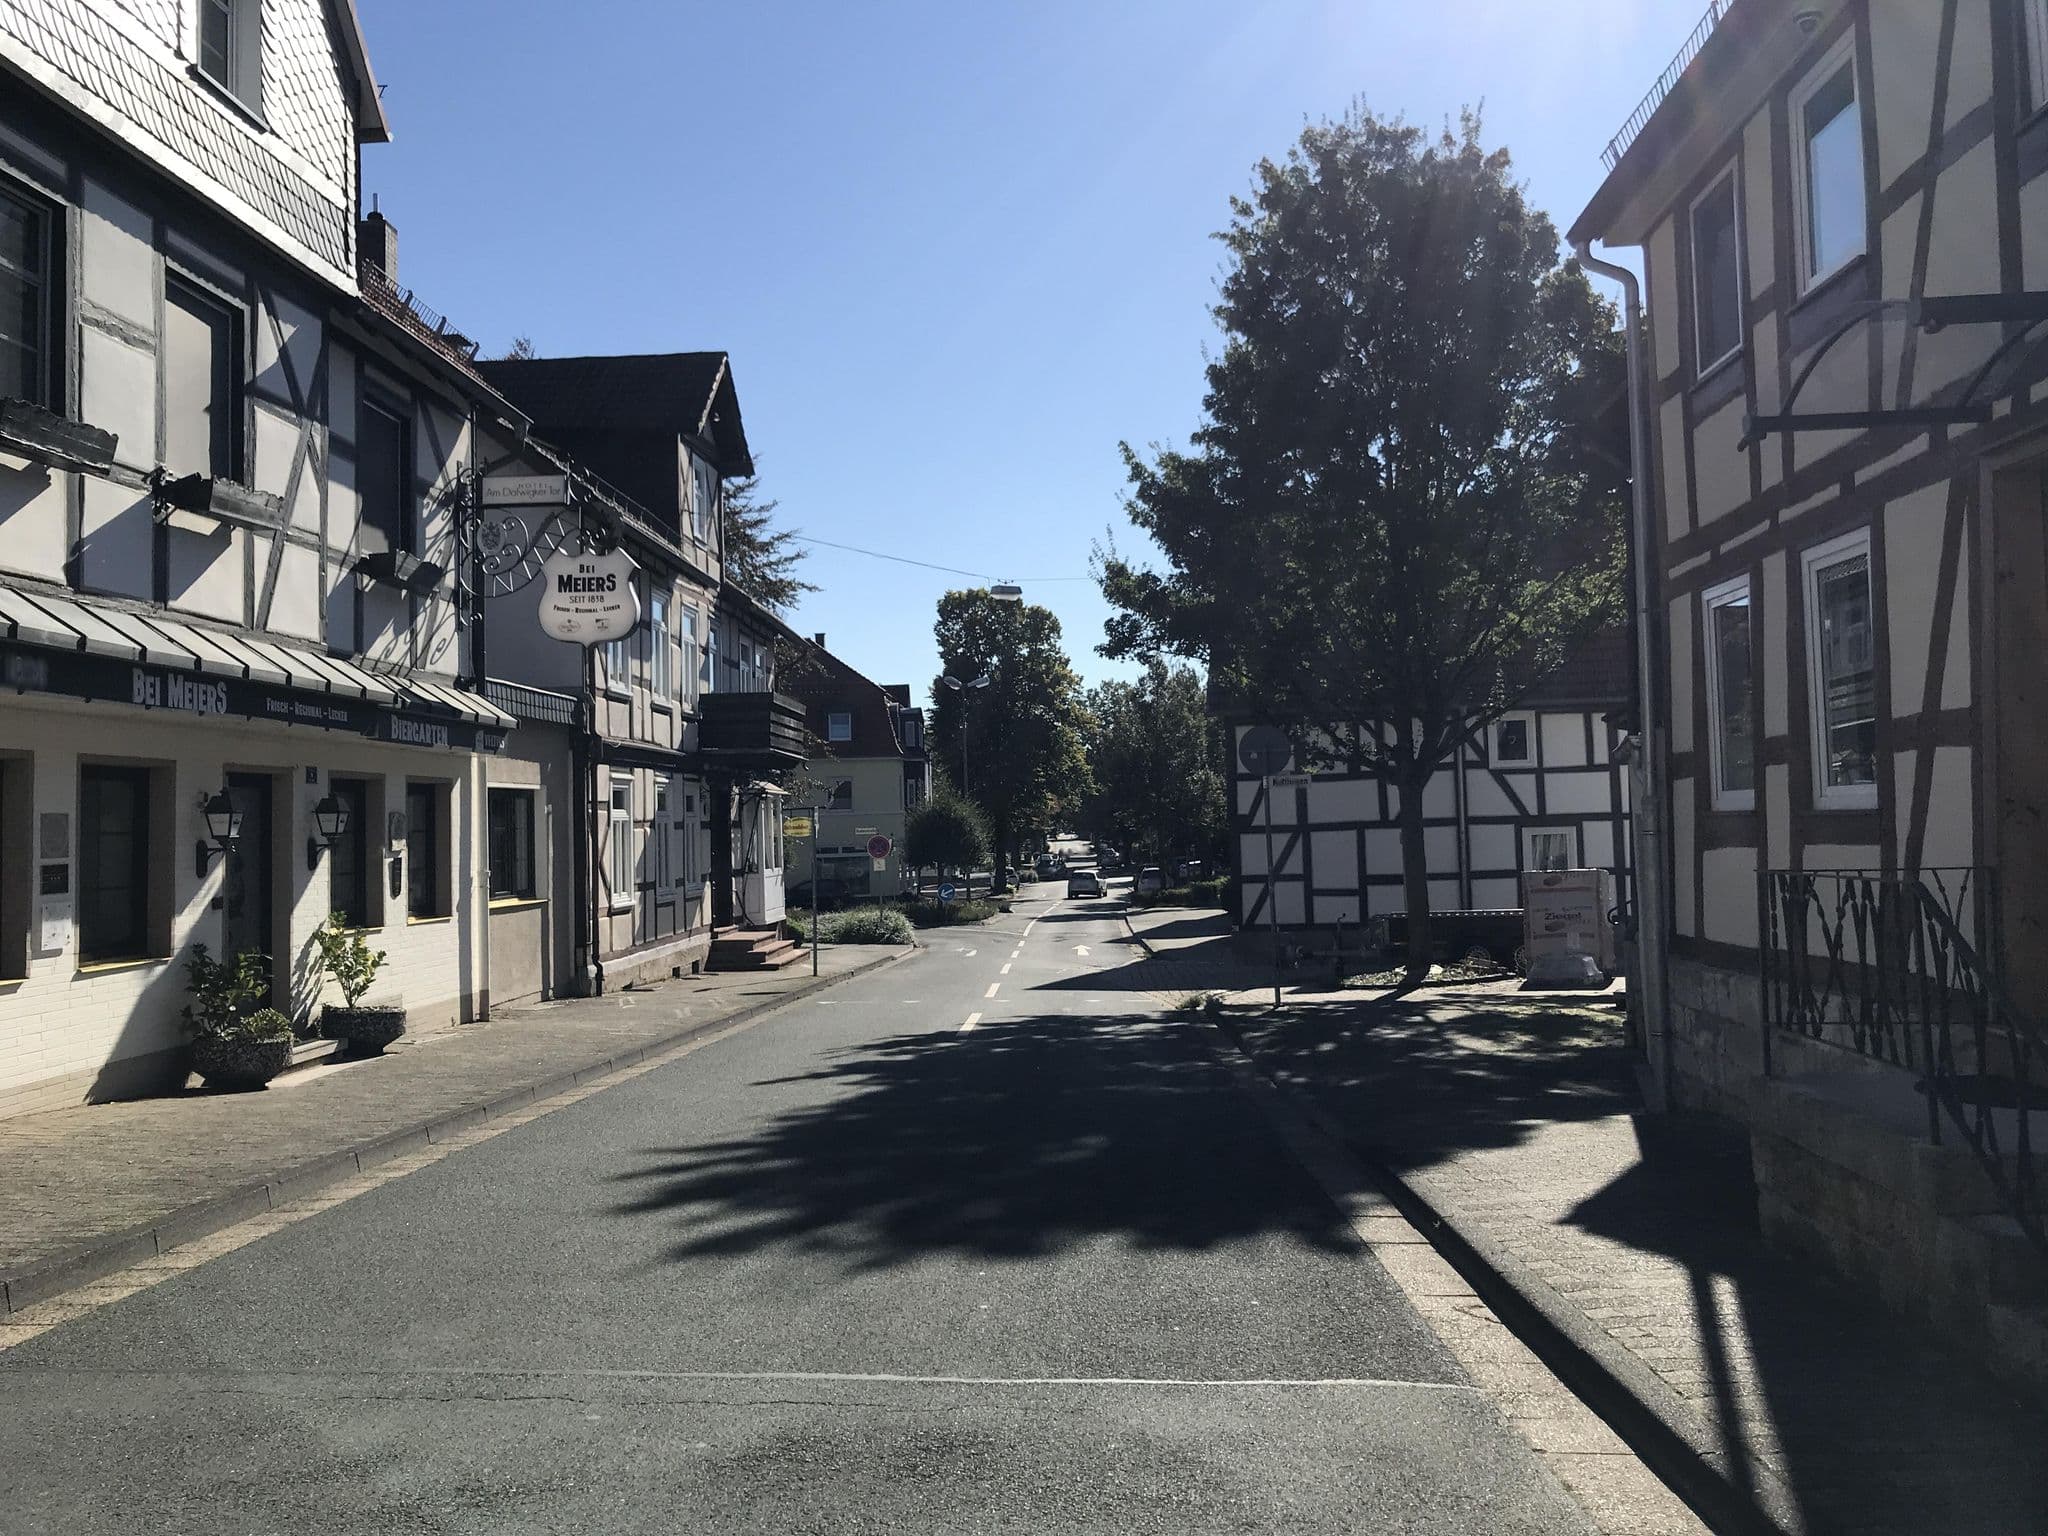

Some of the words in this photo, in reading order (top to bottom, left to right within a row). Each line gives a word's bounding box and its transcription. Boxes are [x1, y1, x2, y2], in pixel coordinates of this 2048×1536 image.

[487, 487, 500, 497] Am
[579, 564, 595, 573] BEI
[557, 573, 617, 593] MEIERS
[569, 595, 586, 604] SEIT
[132, 667, 160, 705] BEI
[167, 672, 228, 714] MEIERS
[391, 713, 448, 746] BIERGARTEN
